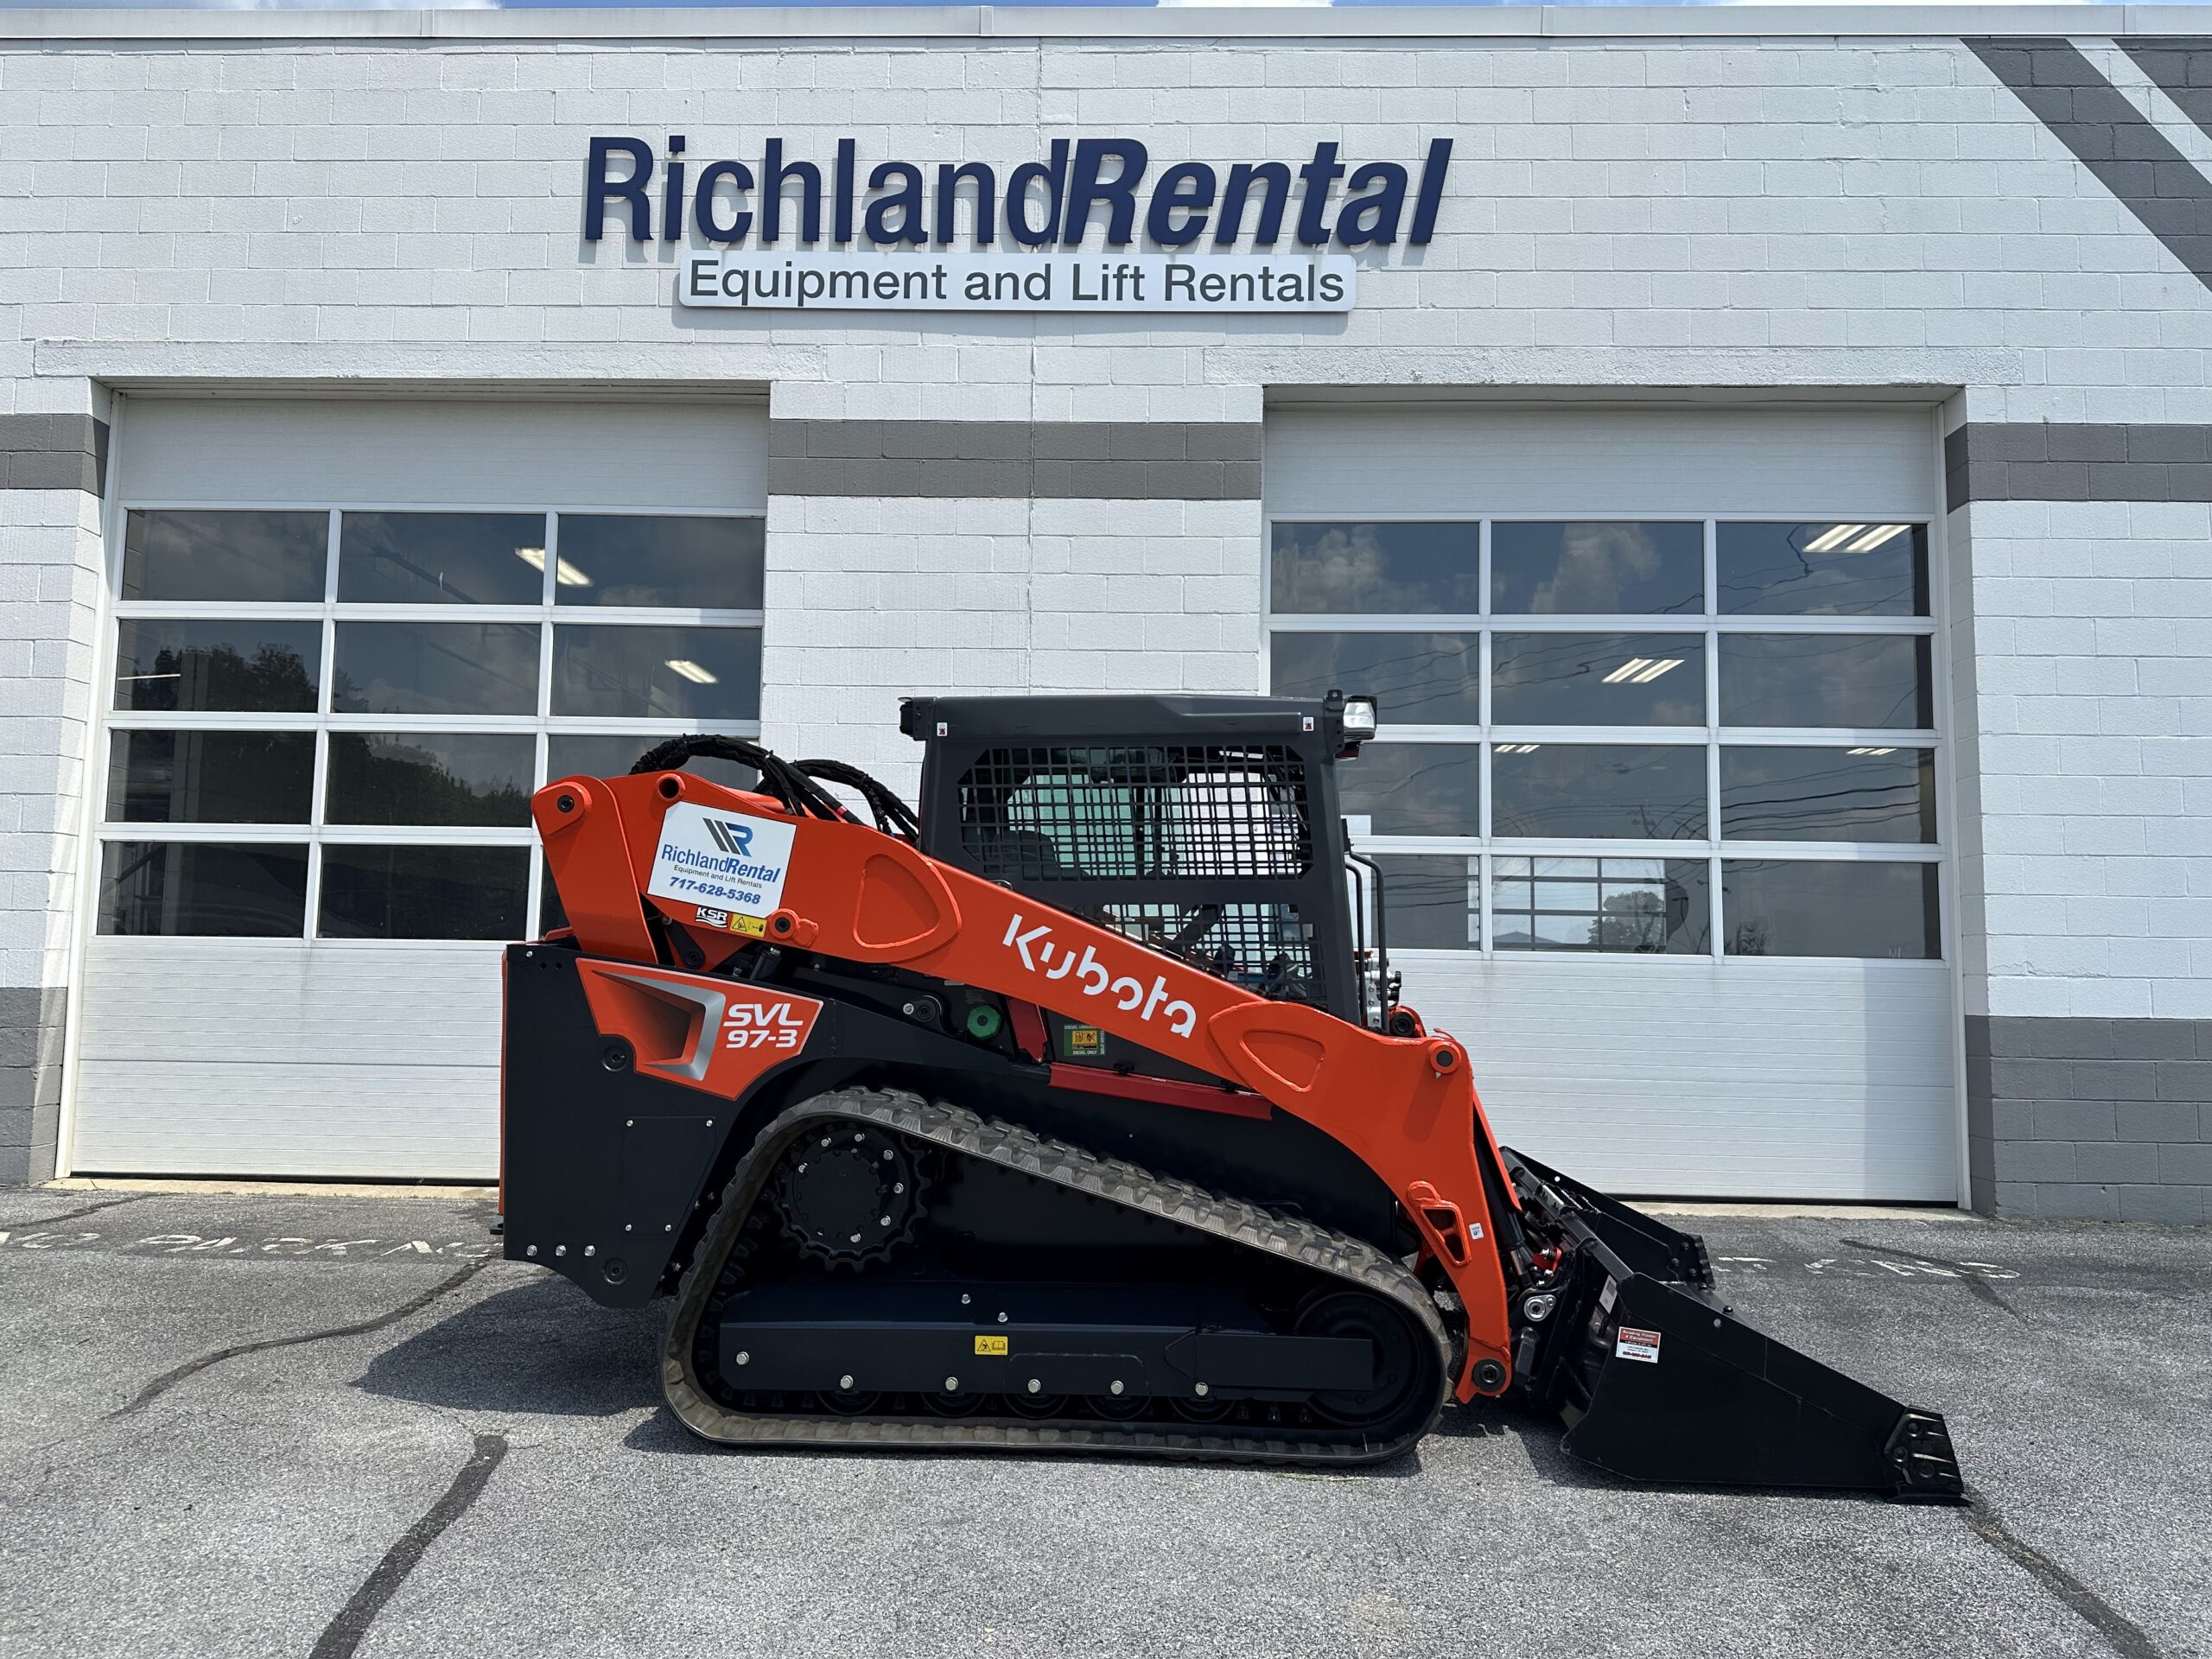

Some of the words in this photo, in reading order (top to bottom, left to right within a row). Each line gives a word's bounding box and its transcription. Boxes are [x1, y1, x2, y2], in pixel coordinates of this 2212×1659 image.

[689, 259, 947, 306] Equipment
[963, 262, 1053, 301] and
[1072, 263, 1146, 302] Lift
[1164, 264, 1345, 303] Rentals
[673, 864, 709, 879] Equipment
[710, 873, 724, 881] and
[725, 874, 736, 883] Lift
[737, 877, 762, 889] Rentals
[669, 876, 761, 905] 717-628-5368
[696, 907, 728, 922] KSR
[1002, 913, 1198, 1039] Kubota
[722, 1003, 804, 1027] SVL
[726, 1029, 798, 1049] 97-3
